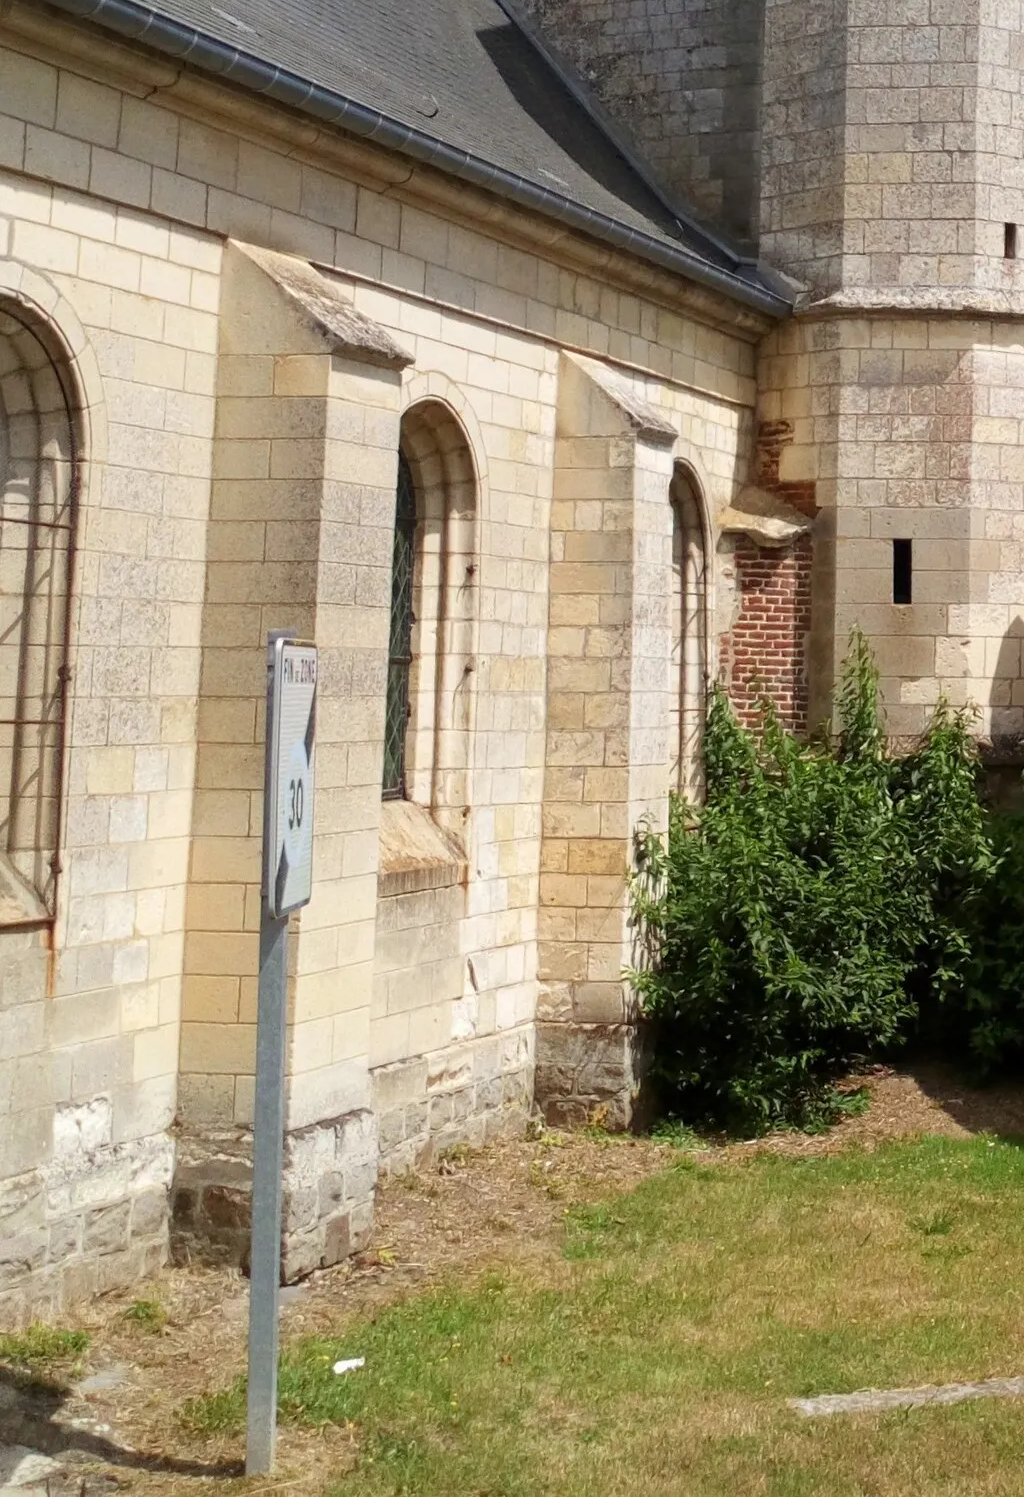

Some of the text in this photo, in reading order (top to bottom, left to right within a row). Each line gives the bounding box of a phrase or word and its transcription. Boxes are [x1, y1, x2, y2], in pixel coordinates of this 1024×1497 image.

[283, 657, 294, 683] FIN
[300, 658, 316, 684] ZONE
[288, 777, 304, 830] 30
